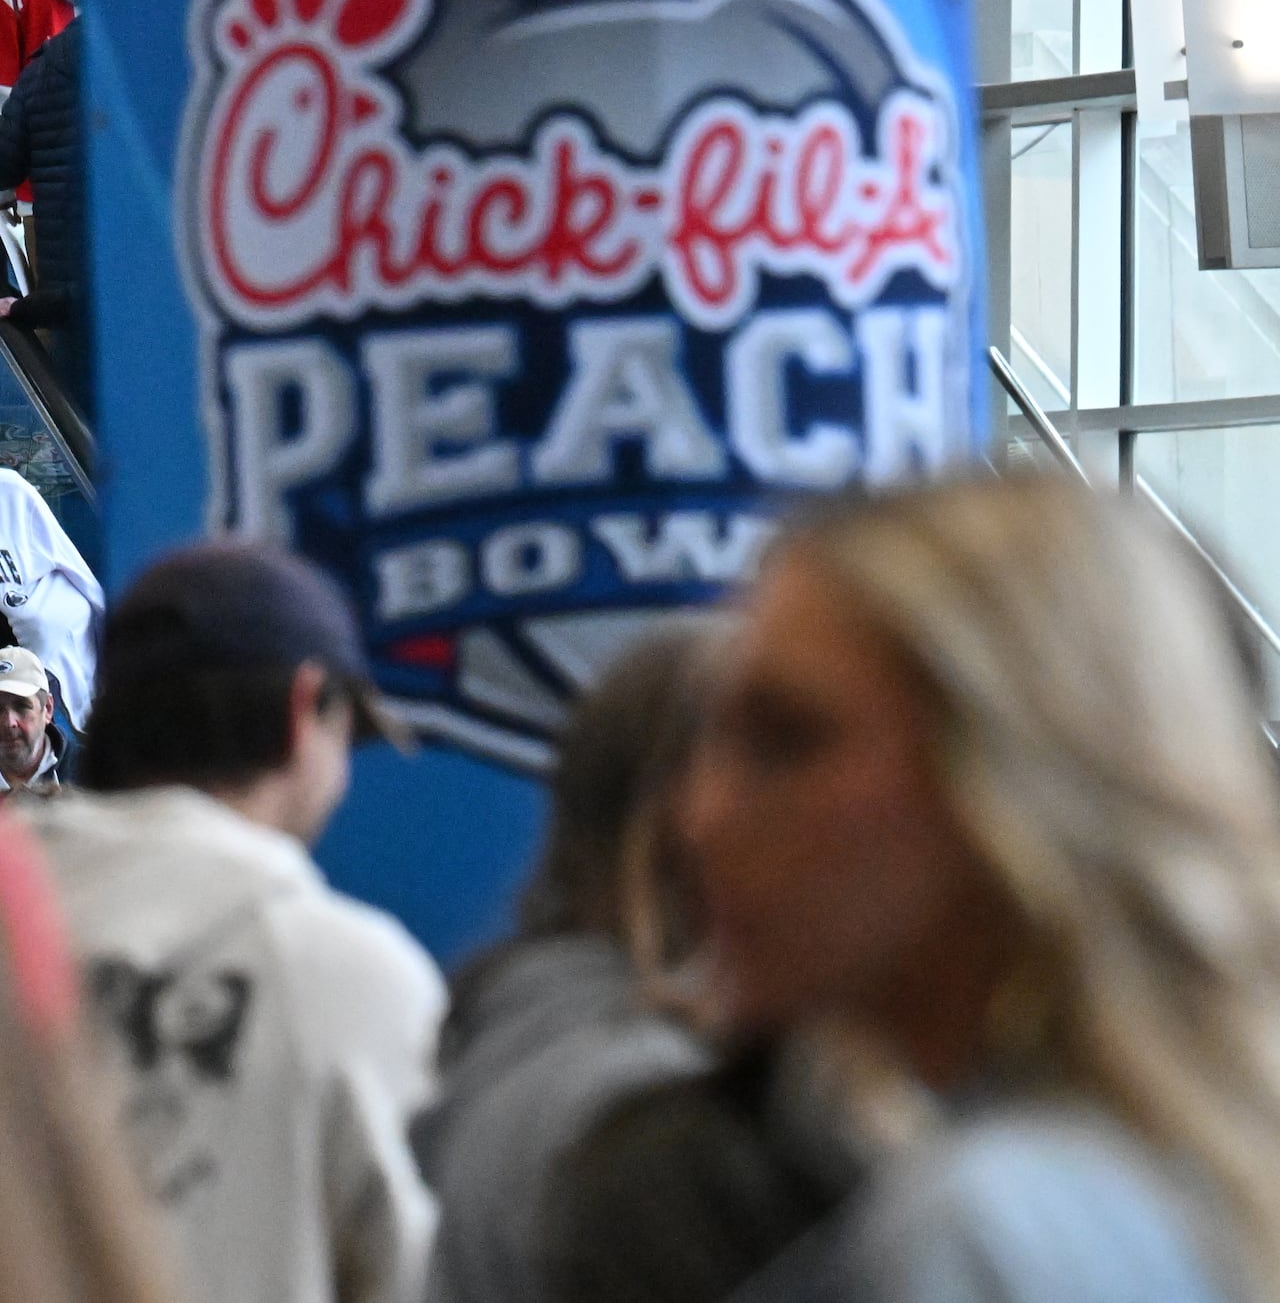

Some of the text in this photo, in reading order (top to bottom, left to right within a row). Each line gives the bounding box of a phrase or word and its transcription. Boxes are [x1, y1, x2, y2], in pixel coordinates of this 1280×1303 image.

[210, 18, 948, 306] Chick-fil-A
[226, 304, 947, 546] PEACH
[375, 512, 778, 620] BOW
